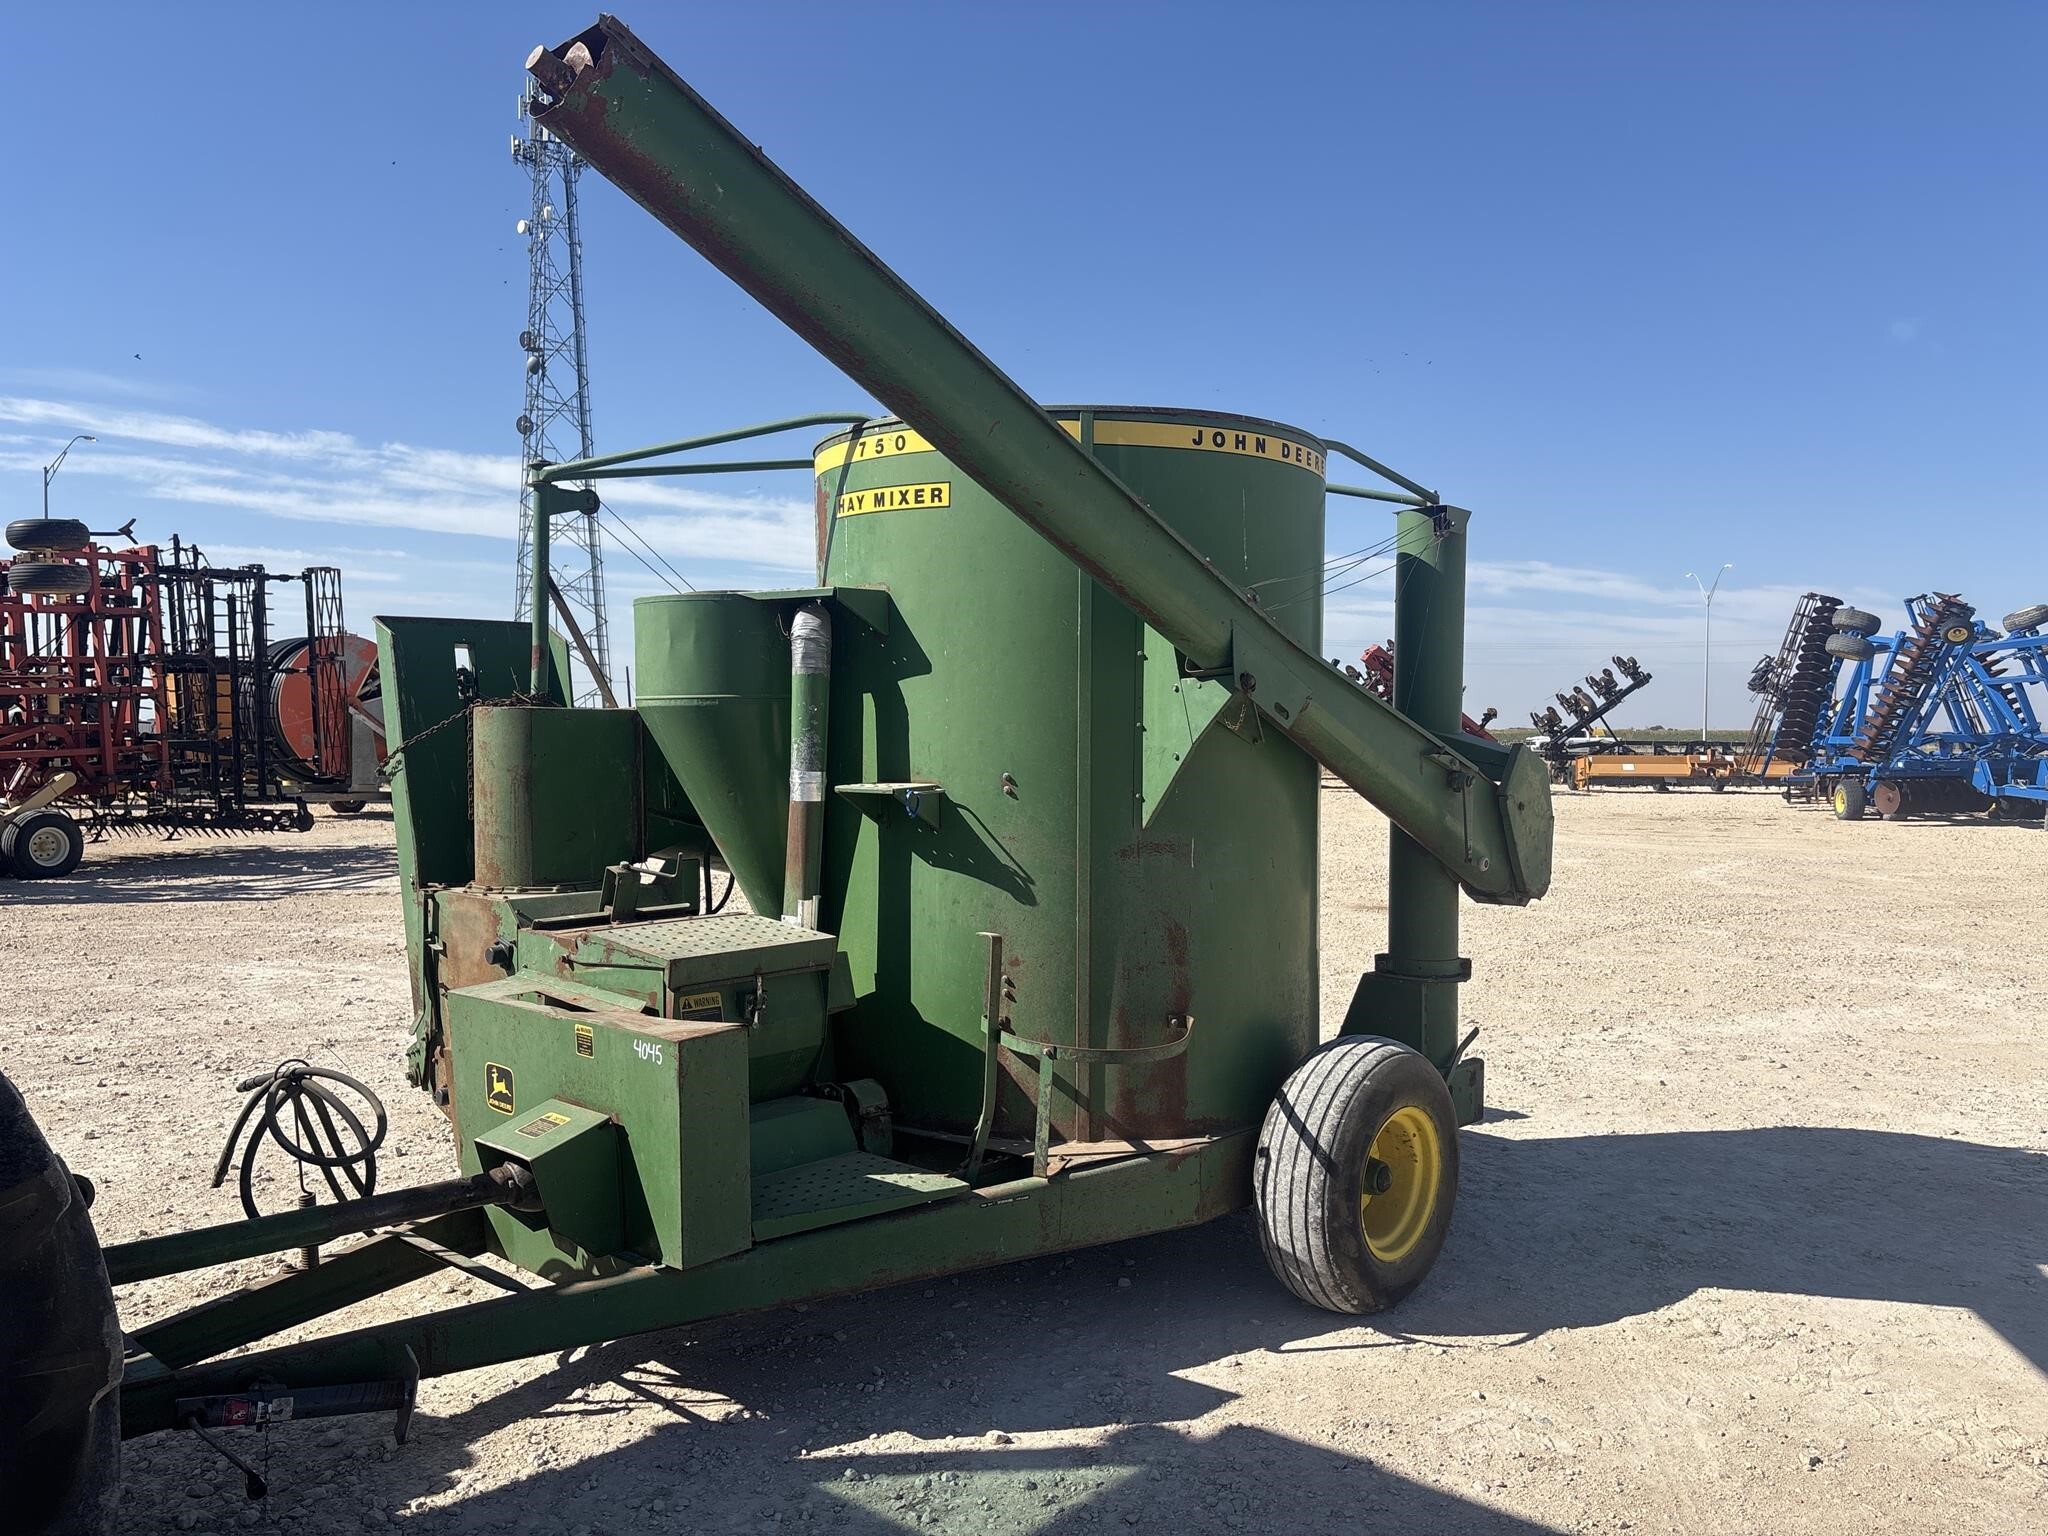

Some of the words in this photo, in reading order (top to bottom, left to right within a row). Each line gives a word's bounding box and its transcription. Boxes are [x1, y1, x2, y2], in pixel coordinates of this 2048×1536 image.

[859, 435, 906, 457] 750
[1192, 430, 1266, 454] JOHN
[1281, 442, 1325, 475] DEERE
[838, 495, 865, 514] HAY
[874, 487, 943, 508] MIXER
[693, 996, 720, 1008] WARNING
[633, 1039, 663, 1065] 4045
